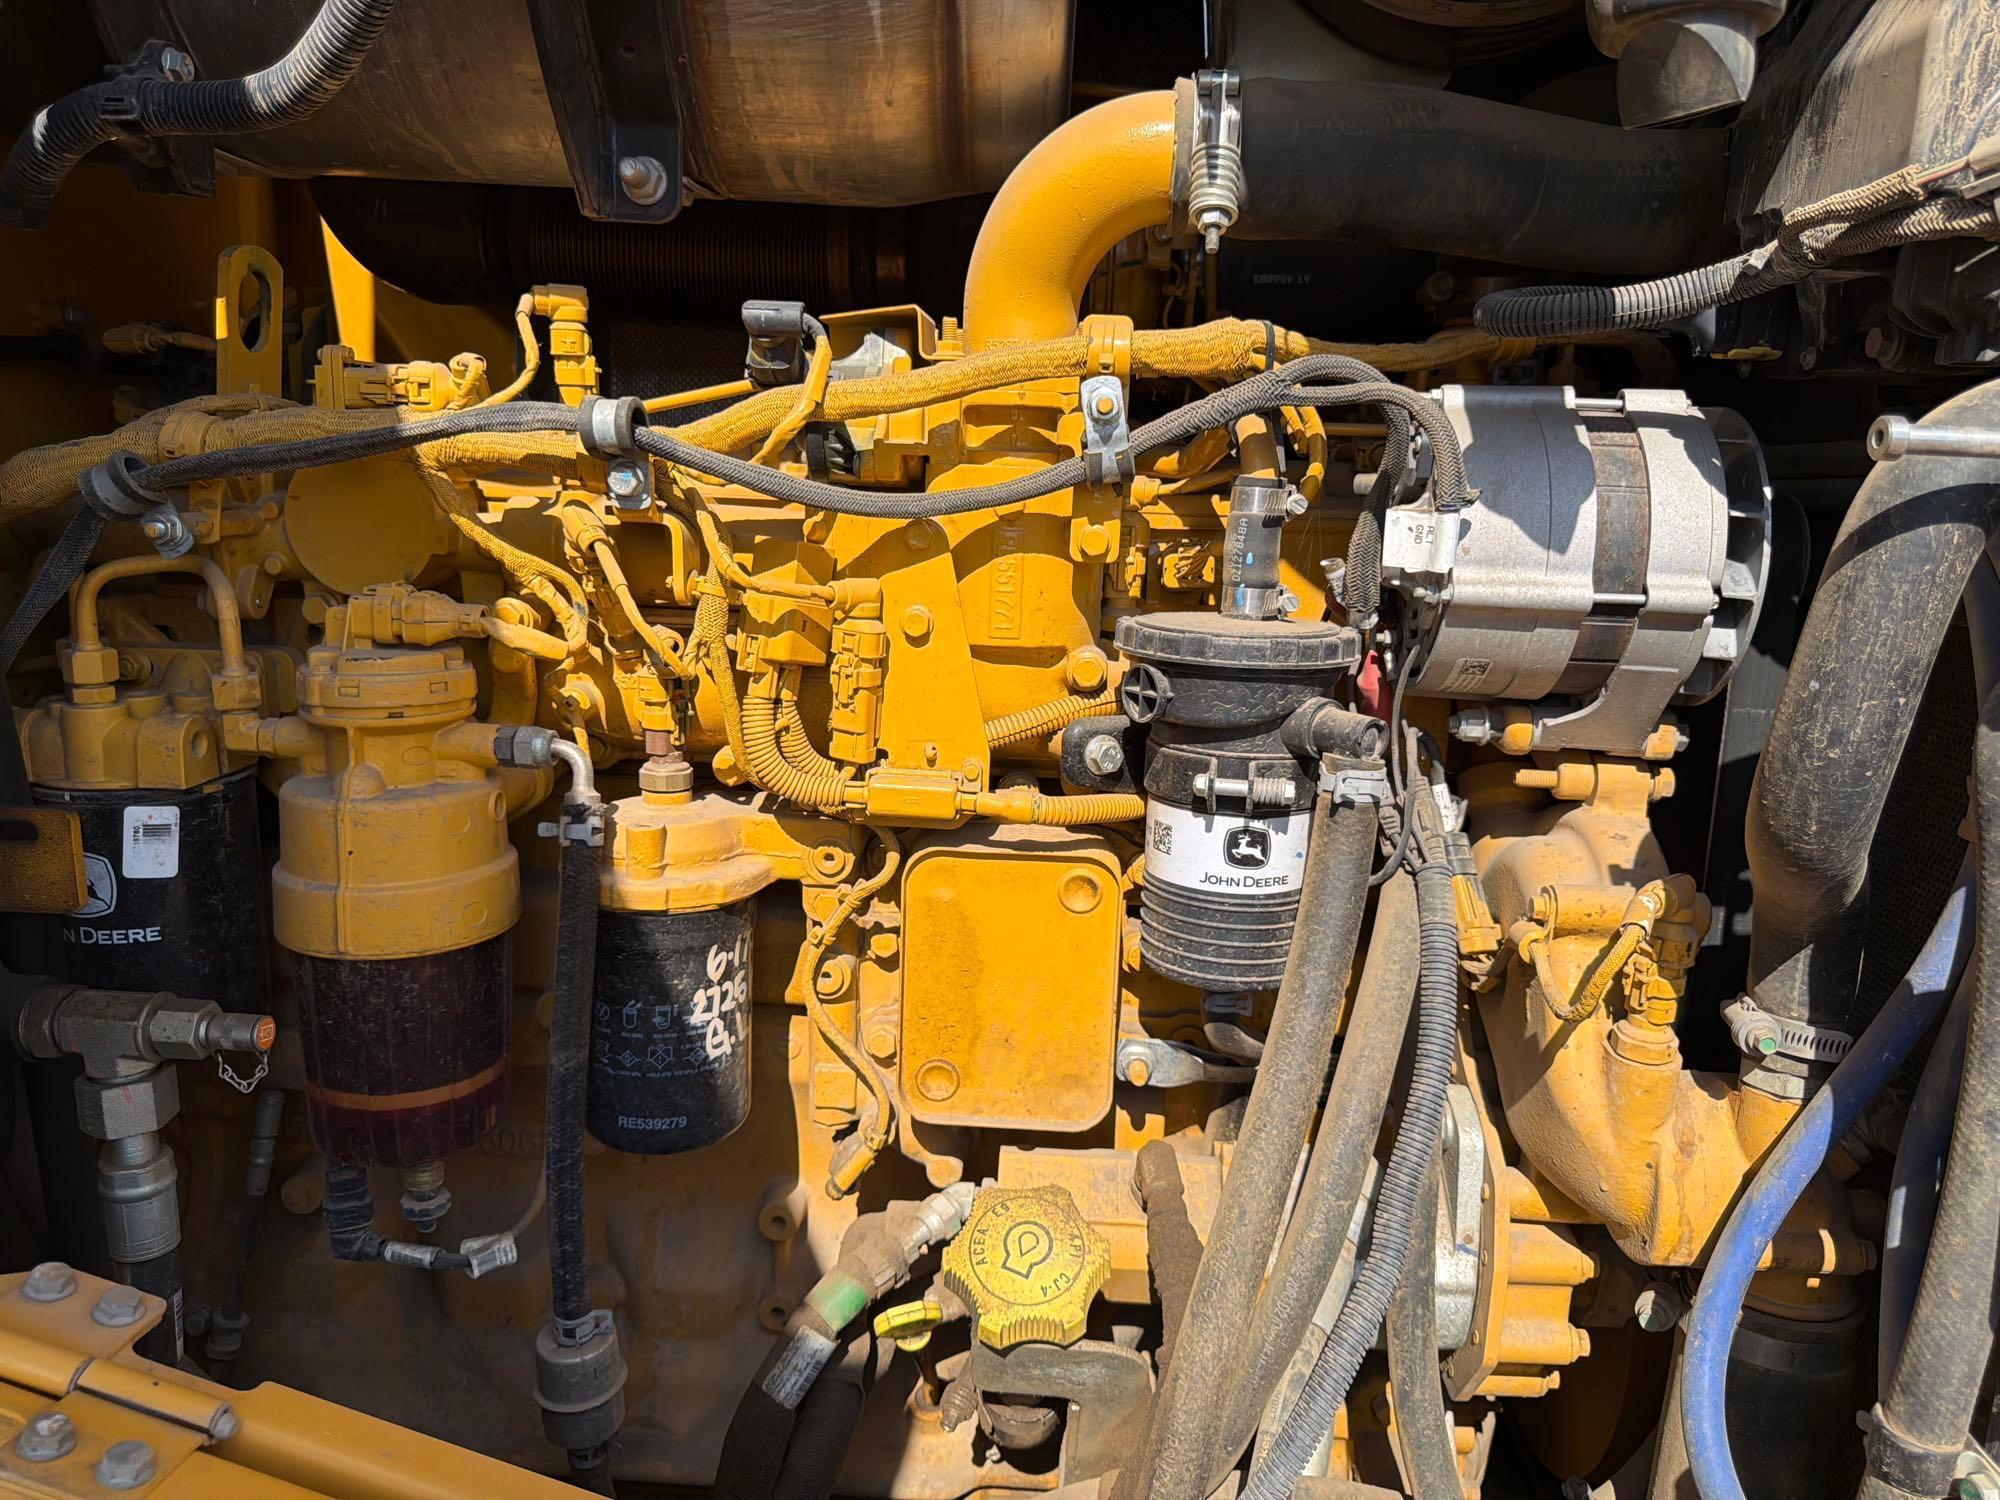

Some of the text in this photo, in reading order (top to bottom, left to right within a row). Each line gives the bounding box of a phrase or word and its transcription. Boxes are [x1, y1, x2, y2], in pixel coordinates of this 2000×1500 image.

[1414, 524, 1424, 545] GND
[1425, 525, 1435, 545] ALT
[1199, 872, 1289, 888] JOHN DEERE
[80, 926, 162, 944] DEERE
[618, 1115, 688, 1131] RE539279
[973, 1227, 989, 1266] ACEA
